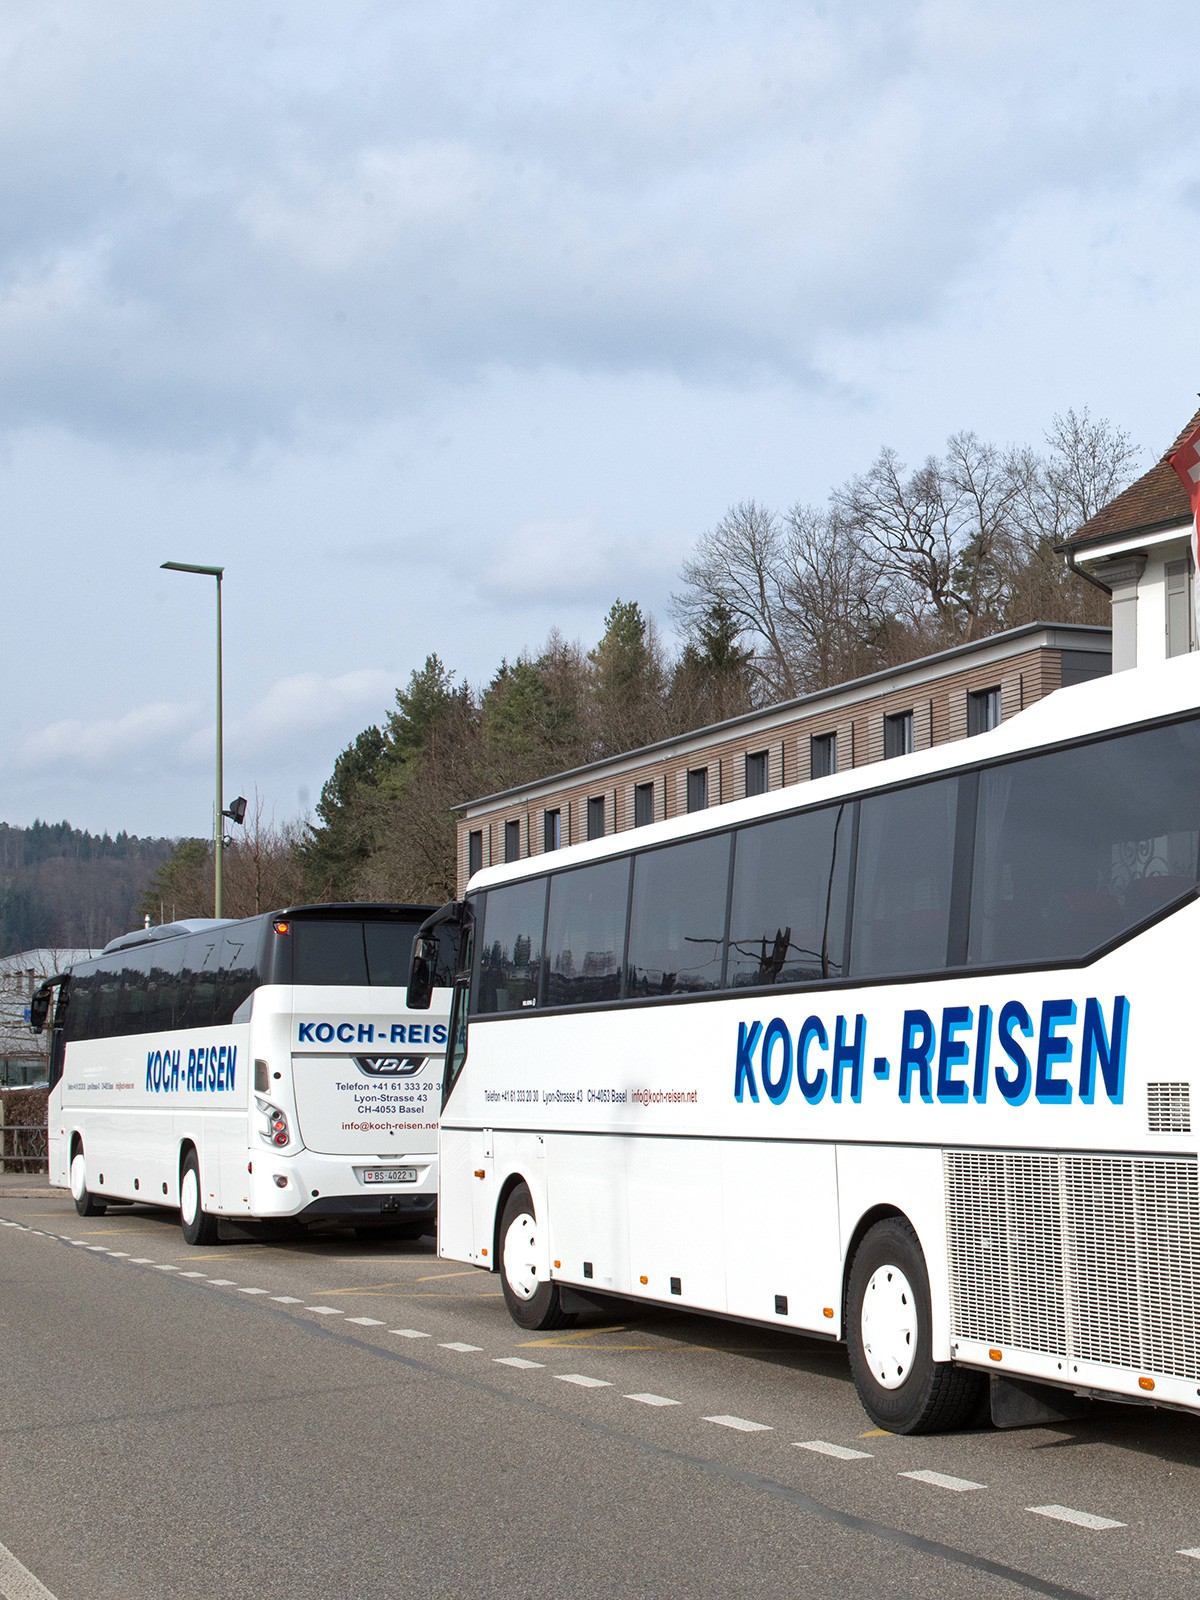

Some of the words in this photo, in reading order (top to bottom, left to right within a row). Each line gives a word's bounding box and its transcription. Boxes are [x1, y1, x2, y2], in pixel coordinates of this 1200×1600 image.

[298, 1022, 450, 1044] KOCH-REIS
[365, 1058, 415, 1072] VDL
[336, 1082, 370, 1091] Telefon
[372, 1082, 388, 1091] +41
[391, 1082, 402, 1091] 61
[404, 1082, 421, 1091] 333
[423, 1082, 434, 1091] 20
[354, 1094, 415, 1104] Lyon-Strasse
[417, 1094, 428, 1102] 43
[611, 1089, 628, 1102] Basel
[631, 1088, 698, 1106] info@koch-reisen.net
[357, 1105, 397, 1114] CH-4053
[399, 1105, 425, 1114] Basel
[341, 1121, 440, 1132] info@koch-reisen.net
